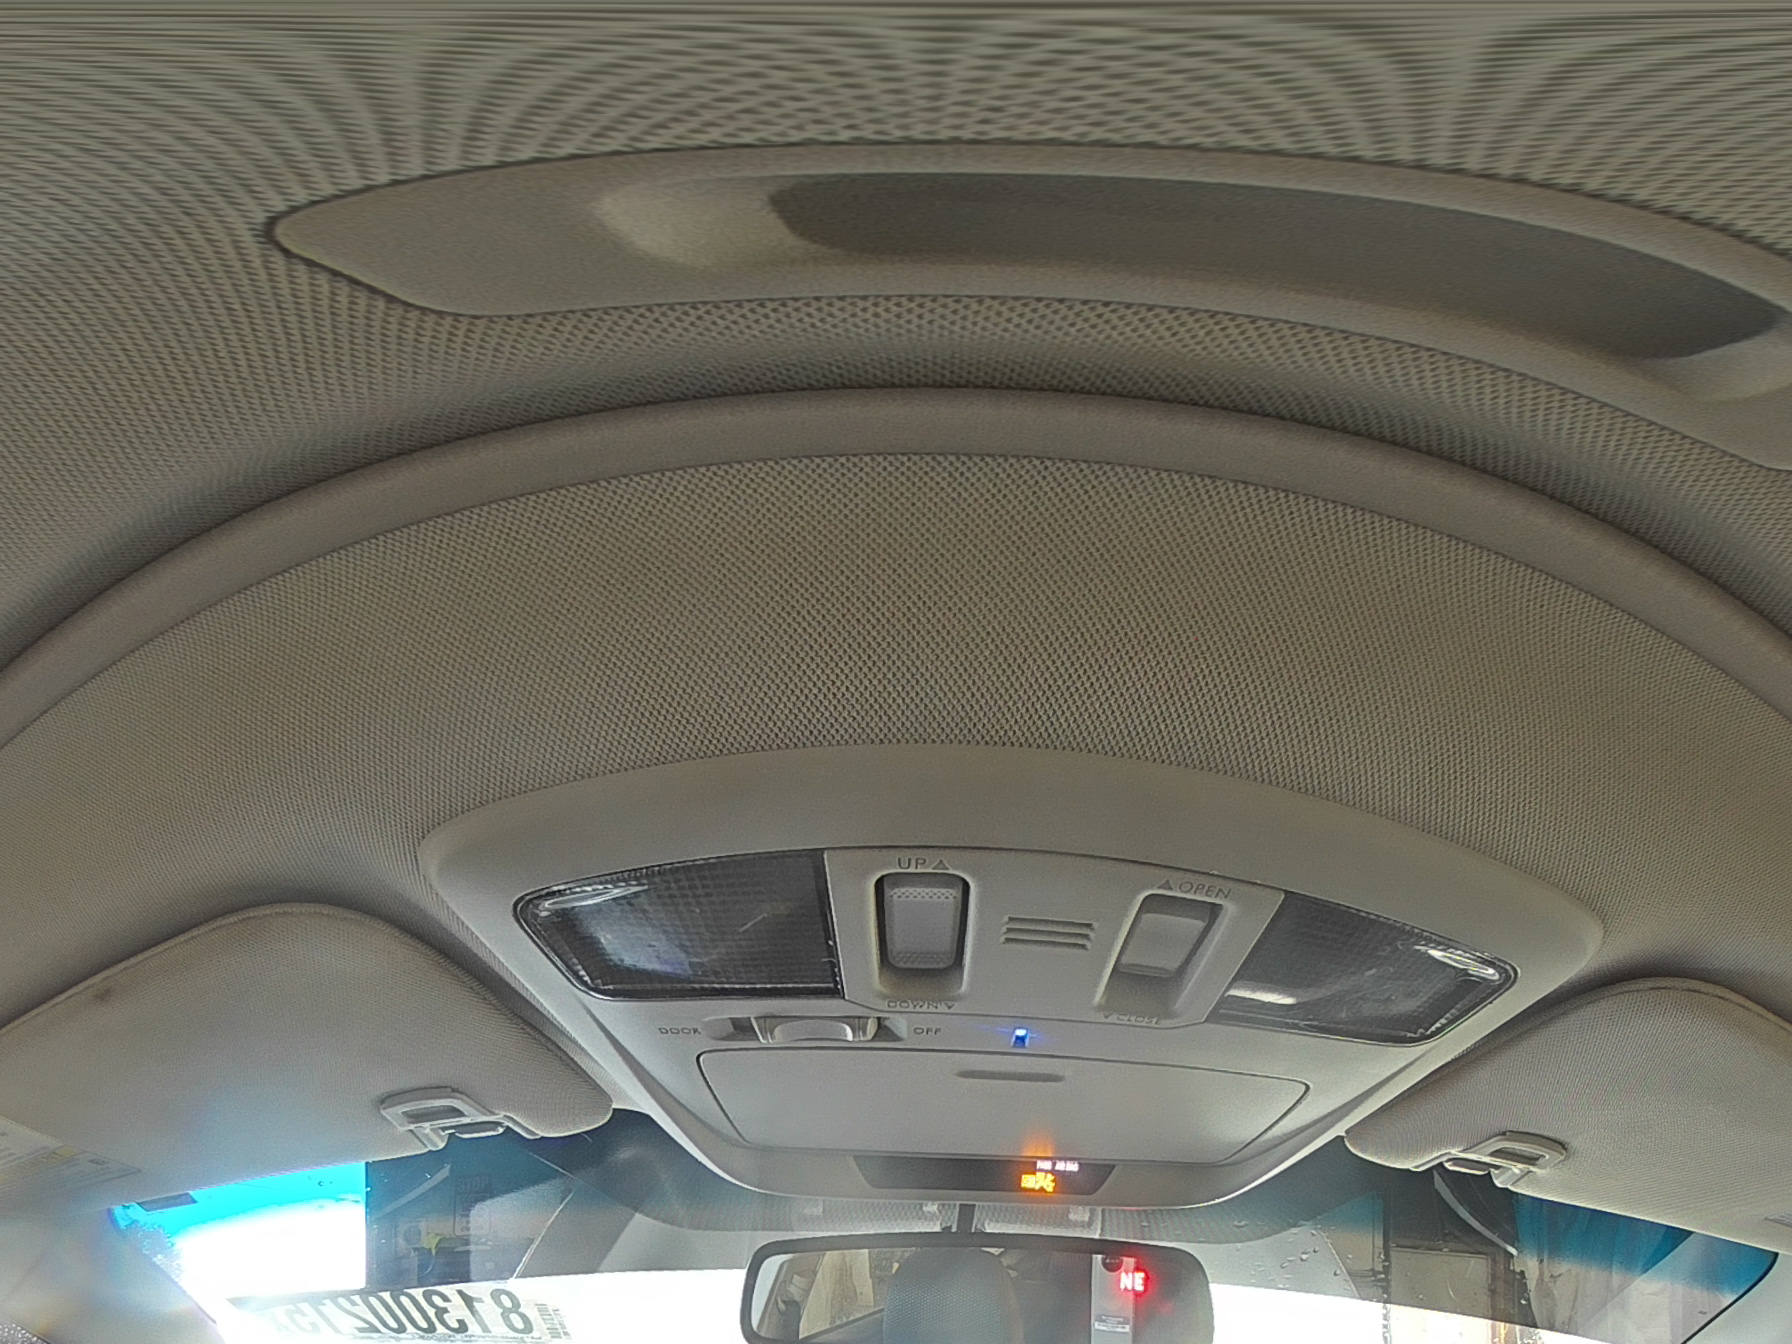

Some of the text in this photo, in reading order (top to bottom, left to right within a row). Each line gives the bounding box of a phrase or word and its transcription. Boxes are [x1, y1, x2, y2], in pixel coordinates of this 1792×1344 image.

[897, 857, 926, 870] UP
[1178, 880, 1231, 899] OPEN
[886, 1000, 940, 1010] DOWN
[1116, 1012, 1162, 1025] CLOSE
[658, 1026, 701, 1035] DOOR
[913, 1026, 942, 1035] OFF
[1120, 1271, 1145, 1292] NE
